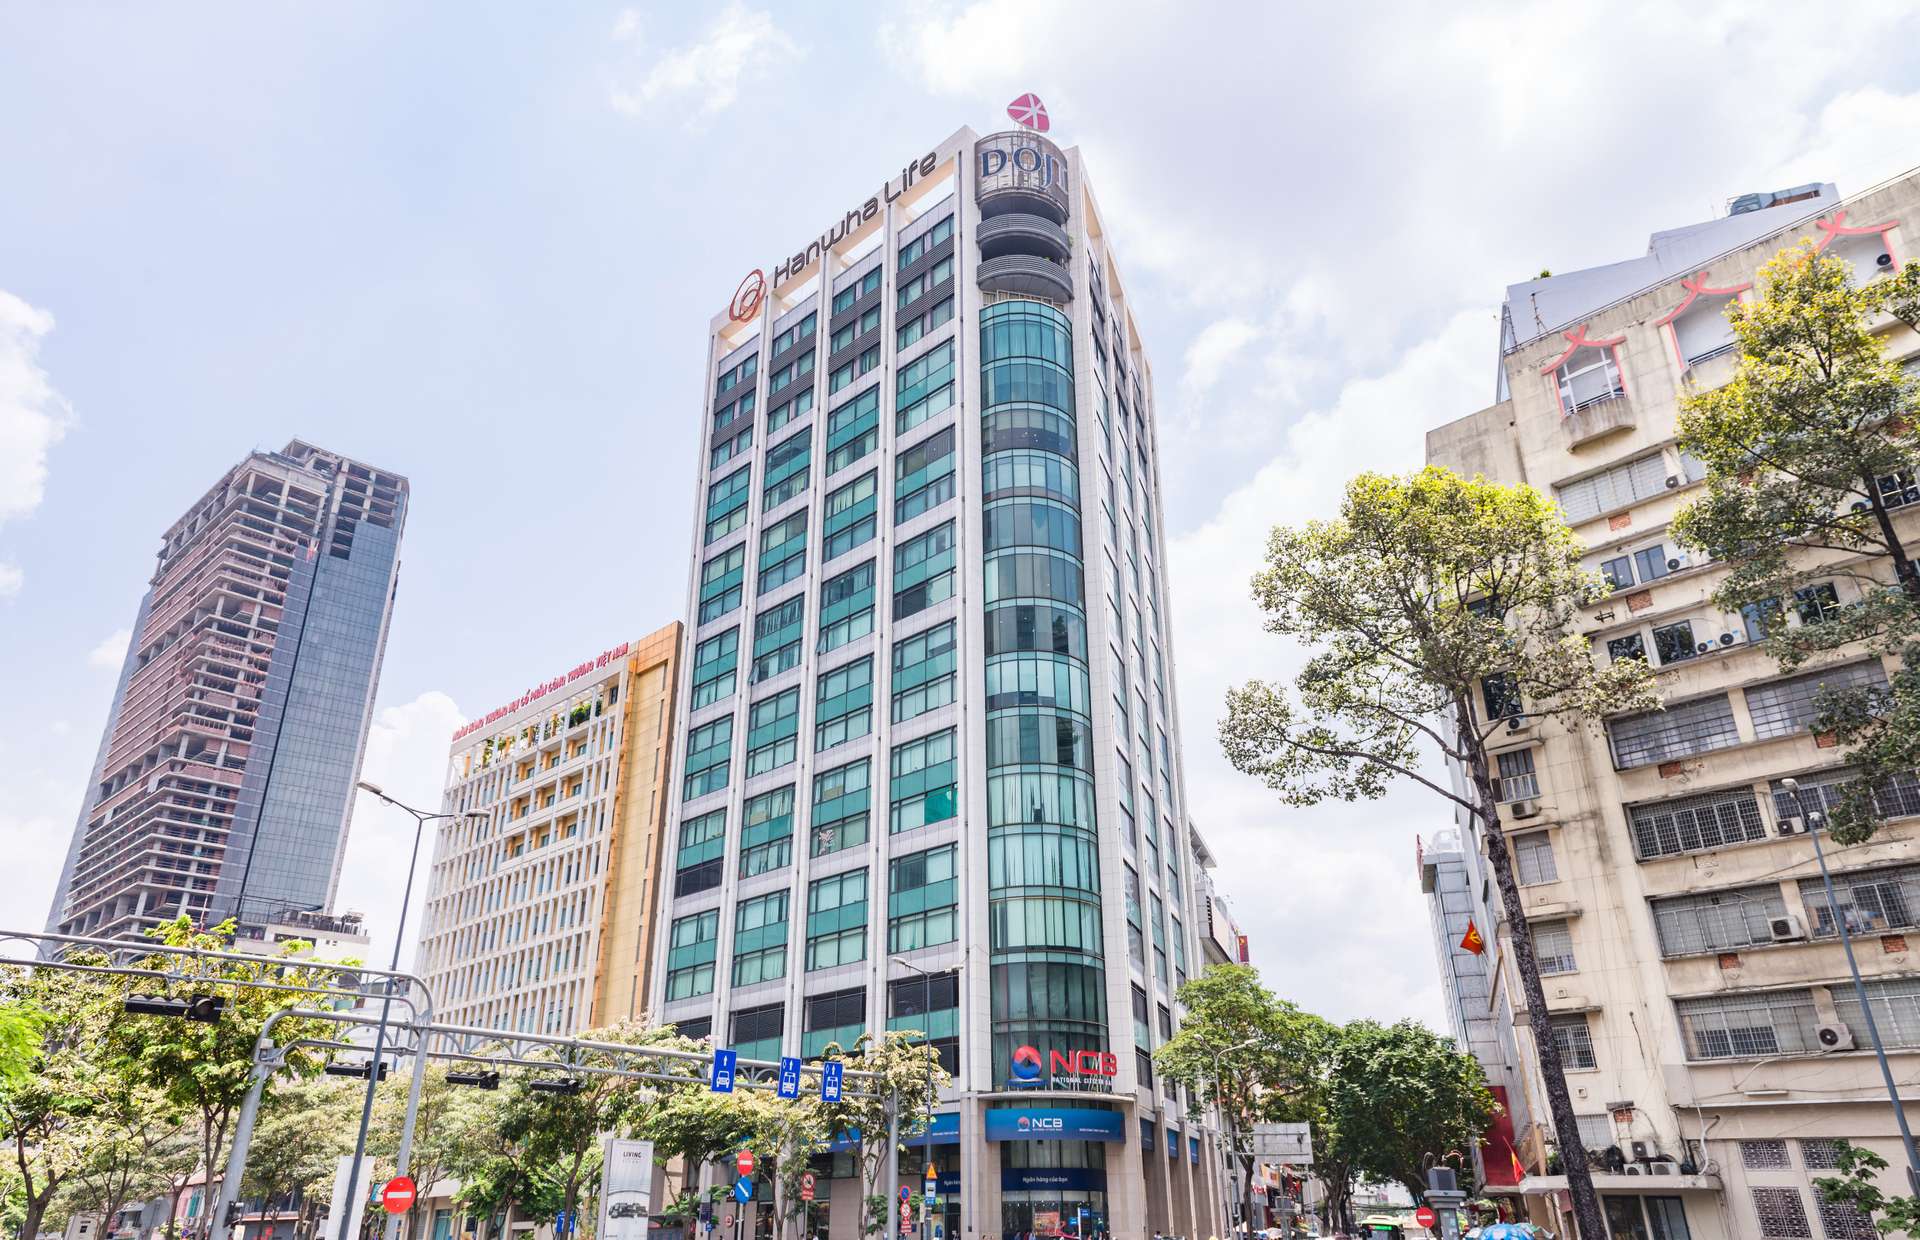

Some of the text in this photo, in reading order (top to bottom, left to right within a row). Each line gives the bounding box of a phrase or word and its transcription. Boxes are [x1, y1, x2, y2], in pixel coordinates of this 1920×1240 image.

[773, 151, 937, 289] Hanwha Life
[1050, 1048, 1117, 1077] NCB
[1051, 1076, 1081, 1084] NATIONAL
[1032, 1117, 1063, 1128] NCB
